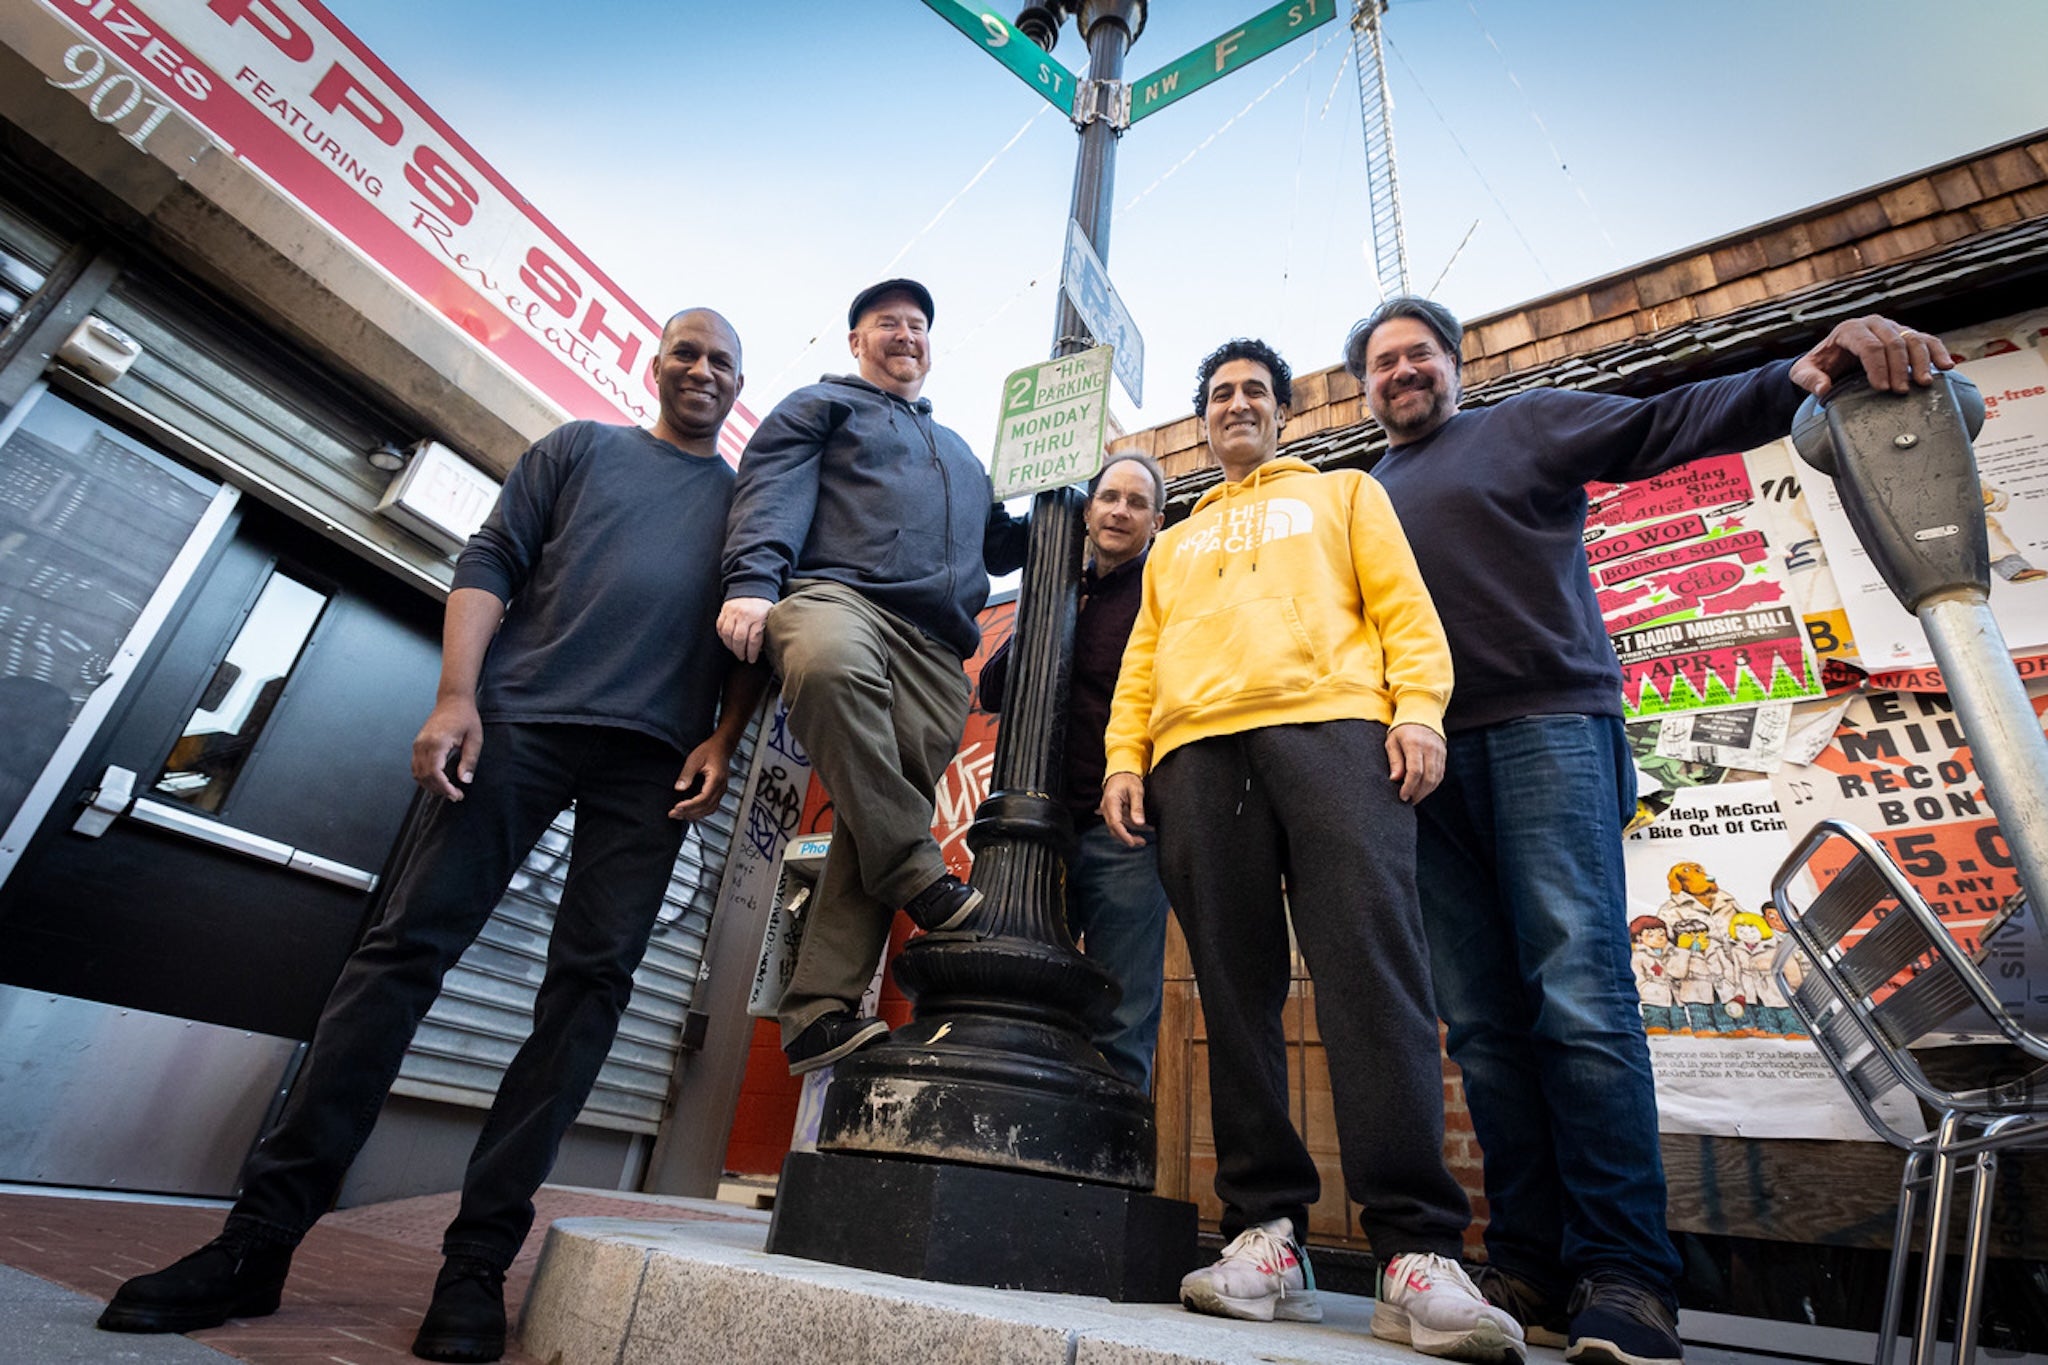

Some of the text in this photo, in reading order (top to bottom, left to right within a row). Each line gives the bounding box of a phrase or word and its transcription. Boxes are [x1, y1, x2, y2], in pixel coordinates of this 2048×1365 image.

[980, 12, 1064, 94] 9 ST
[1145, 71, 1179, 105] NW
[1215, 30, 1245, 73] F
[44, 44, 172, 154] 901
[235, 65, 383, 198] FEATURING
[410, 200, 655, 418] Revelations
[519, 246, 661, 404] SH
[1008, 358, 1086, 410] 2 HR
[1037, 371, 1104, 404] PARKING
[1011, 403, 1091, 440] MONDAY
[1023, 430, 1075, 459] THRU
[1008, 451, 1080, 485] FRIDAY
[1636, 520, 1697, 545] WOP
[1605, 551, 1683, 581] BOUNCE
[1689, 533, 1758, 557] SQUAD
[1677, 570, 1737, 594] CELO
[1636, 624, 1683, 649] RADIO
[1687, 615, 1743, 639] MUSIC
[1745, 610, 1792, 629] HALL
[1651, 653, 1726, 680] APR.
[1732, 648, 1752, 666] 3
[1837, 757, 1984, 799] RECO
[1670, 806, 1709, 823] Help
[1878, 789, 1994, 826] BON
[1649, 824, 1683, 840] Bite
[1689, 822, 1719, 837] Out
[1726, 820, 1746, 834] Of
[1938, 876, 1994, 896] ANY
[1724, 1069, 1733, 1078] A
[1757, 1070, 1776, 1078] Out
[1778, 1070, 1791, 1078] Of
[1777, 1050, 1800, 1060] help
